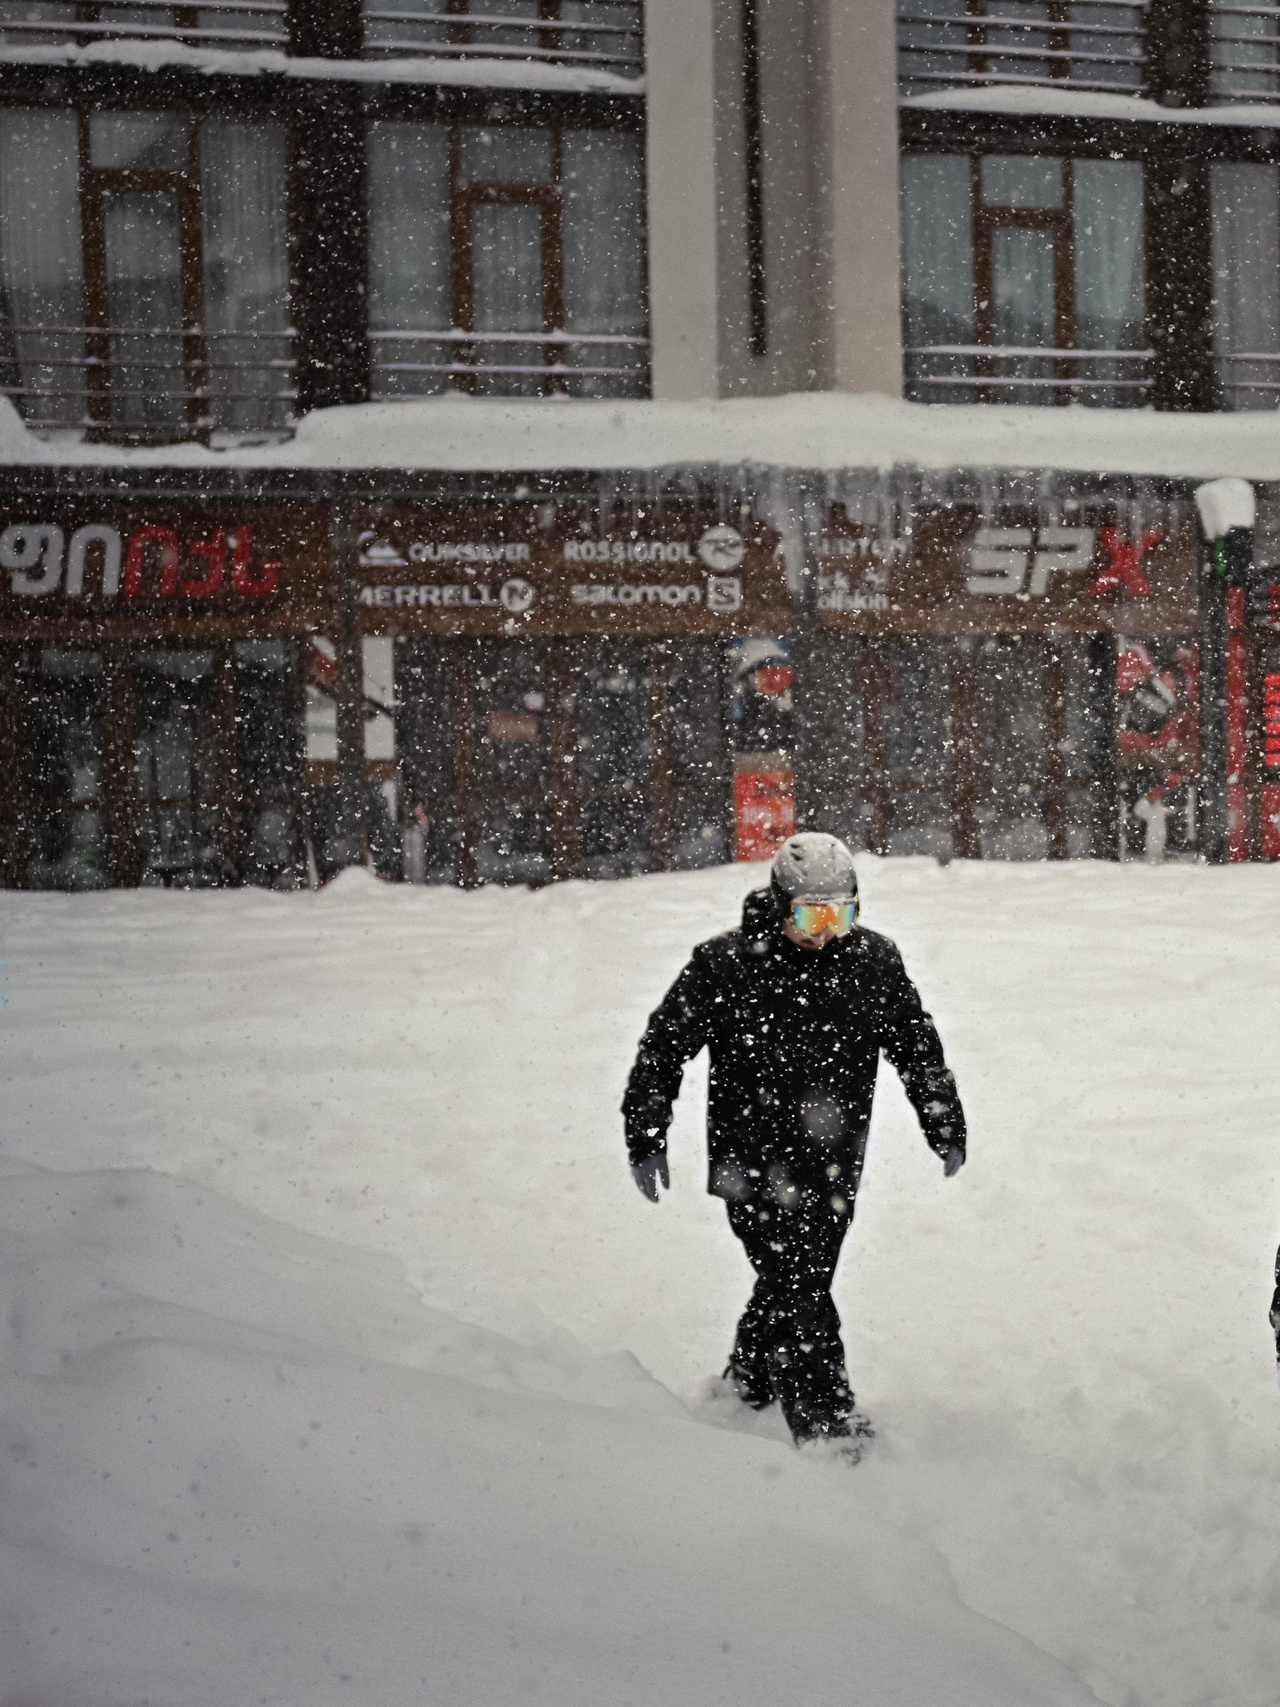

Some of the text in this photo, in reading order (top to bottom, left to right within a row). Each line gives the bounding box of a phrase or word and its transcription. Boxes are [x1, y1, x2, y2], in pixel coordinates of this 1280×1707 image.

[817, 537, 908, 558] URTON
[966, 527, 1167, 595] SPX
[817, 592, 891, 611] olfskin
